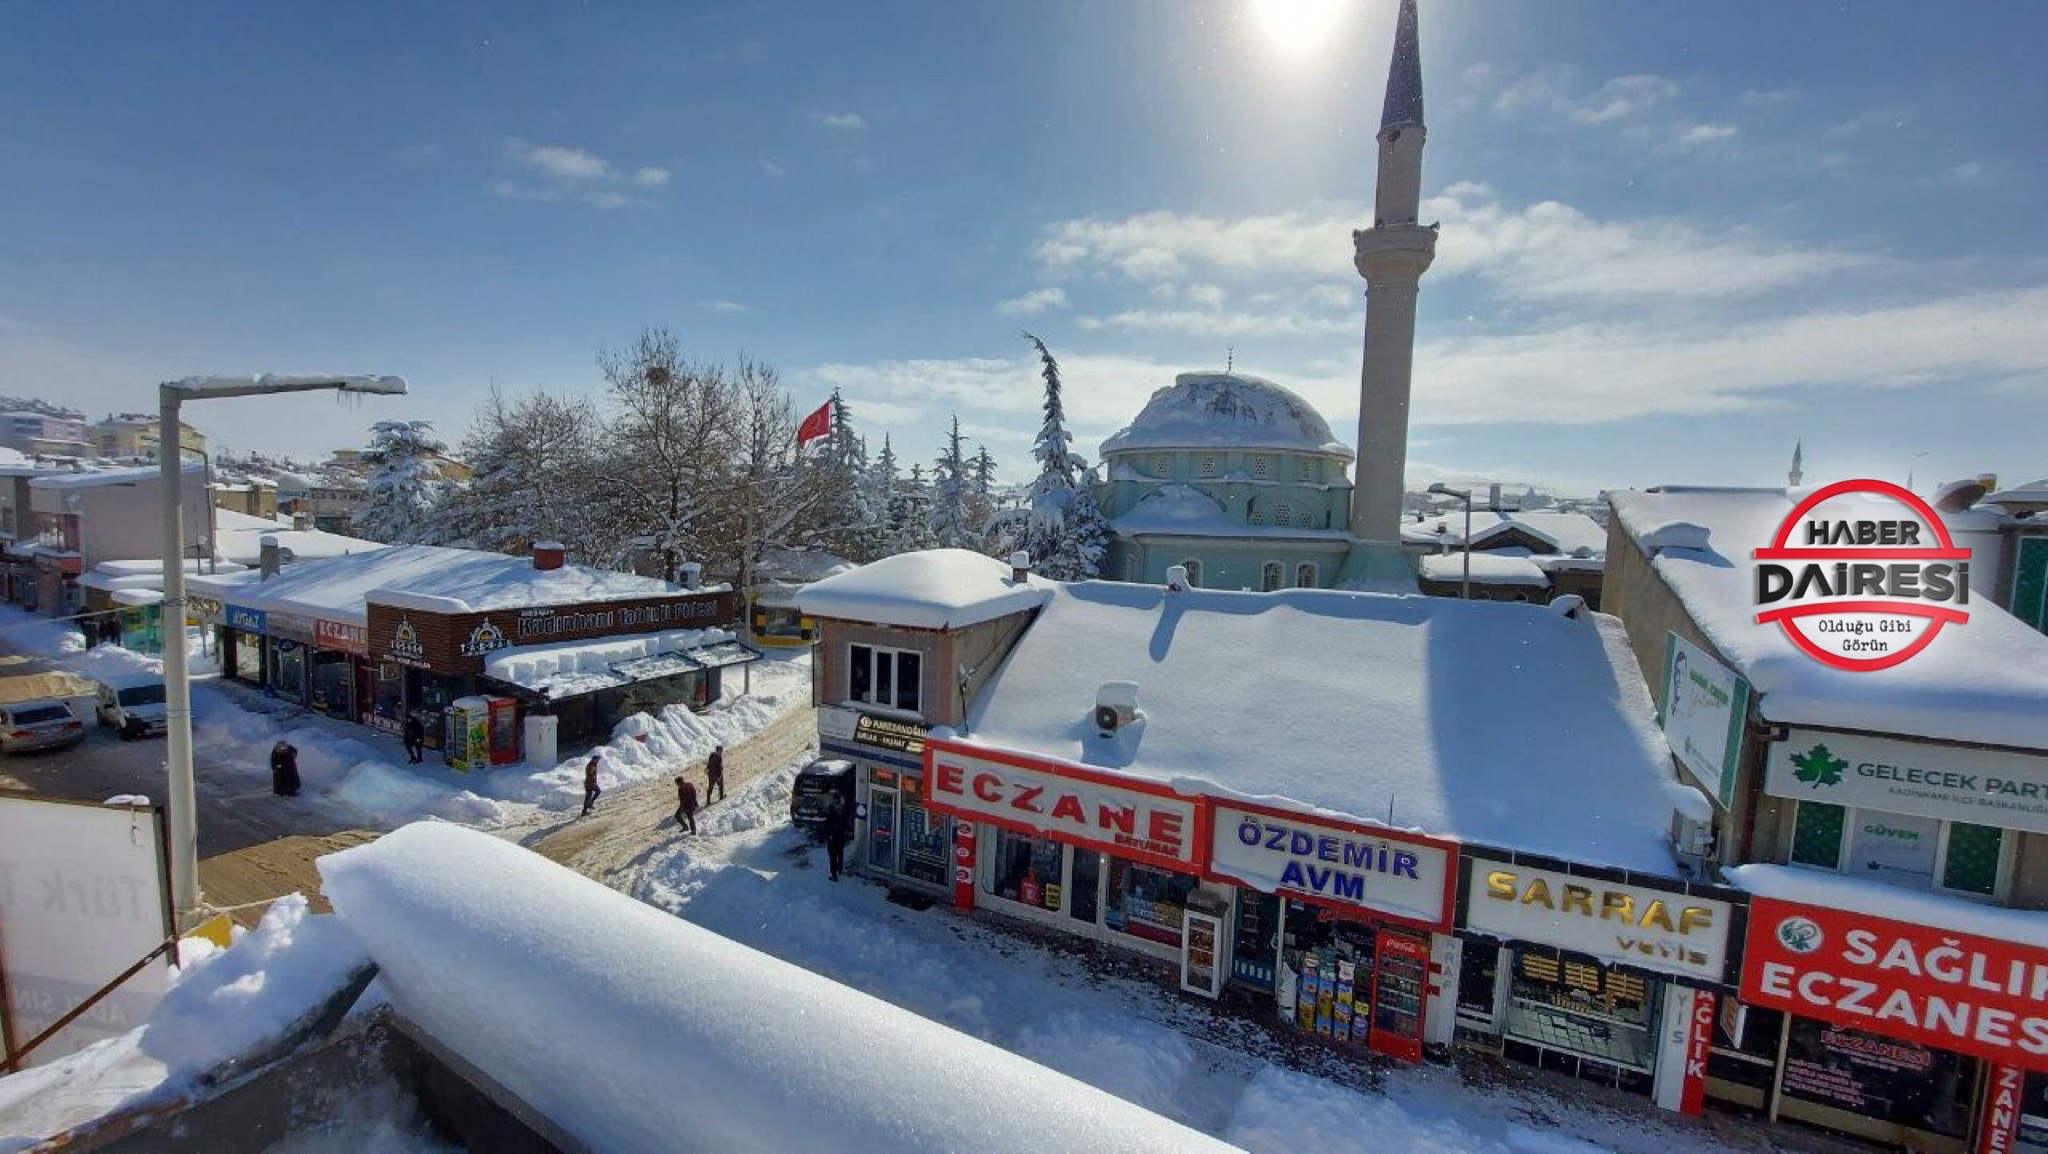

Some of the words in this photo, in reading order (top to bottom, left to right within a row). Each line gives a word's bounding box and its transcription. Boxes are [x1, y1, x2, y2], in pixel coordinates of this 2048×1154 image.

[936, 763, 1184, 847] ECZANE
[1857, 762, 1978, 791] GELECEK
[1237, 815, 1420, 880] ÖZDEMİR
[1279, 860, 1366, 900] AVM
[1486, 870, 1714, 937] SARRAF
